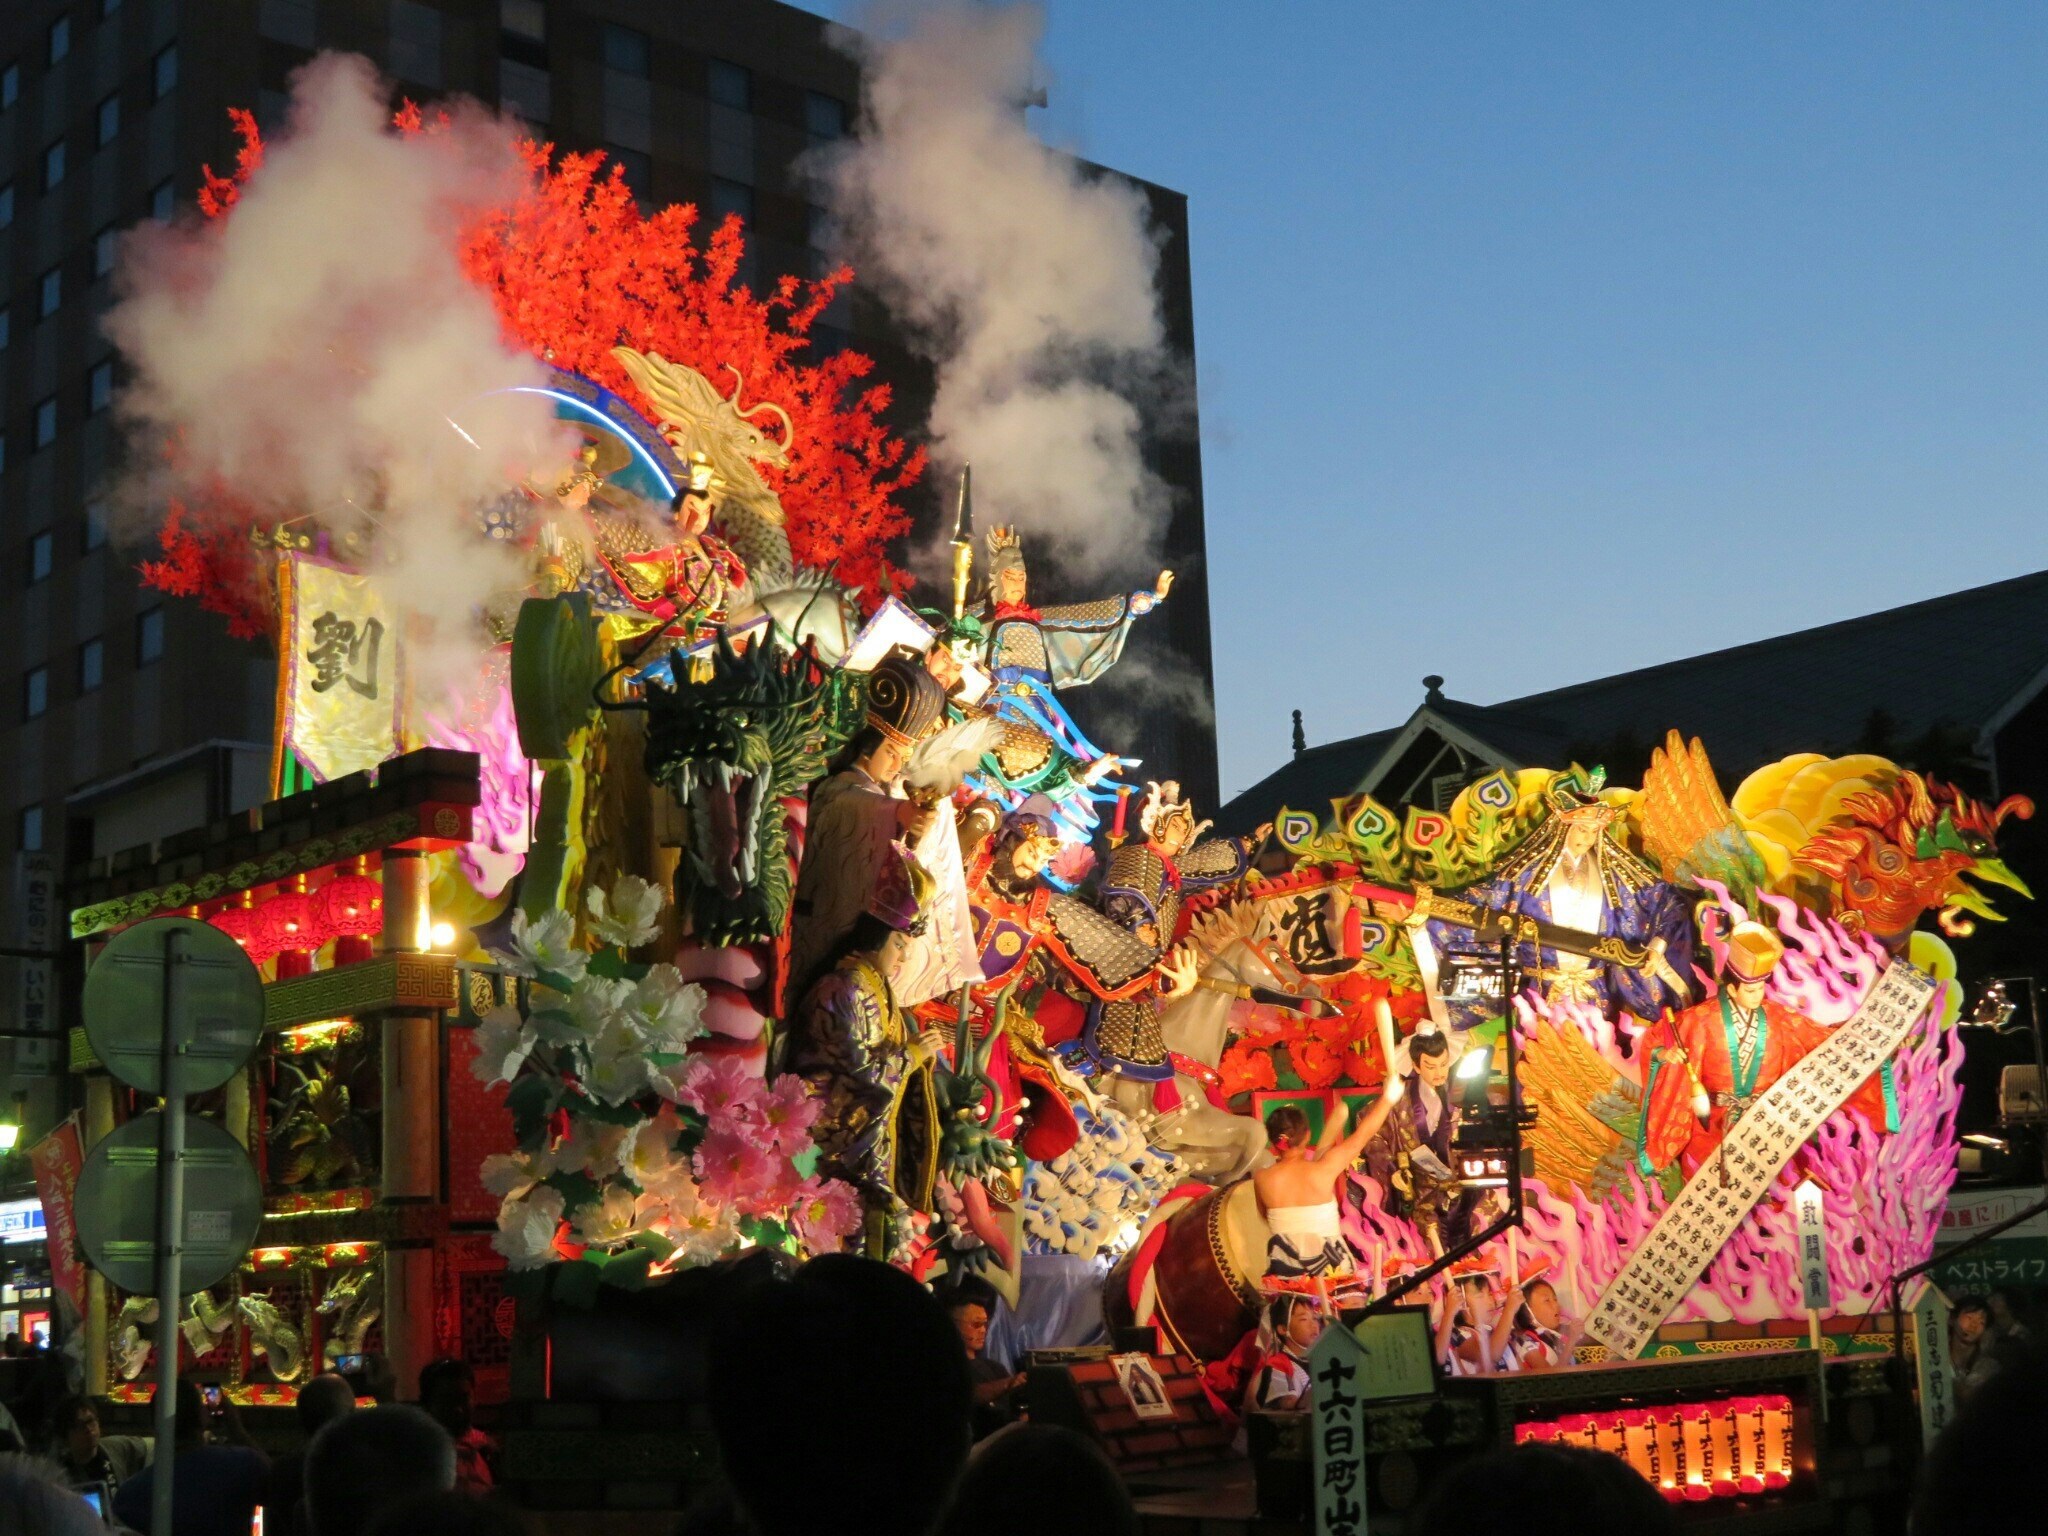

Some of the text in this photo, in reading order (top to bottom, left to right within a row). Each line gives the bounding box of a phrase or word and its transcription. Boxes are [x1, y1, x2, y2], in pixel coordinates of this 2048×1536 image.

[307, 611, 385, 700] 劉
[1947, 1259, 2046, 1280] ベストライフ
